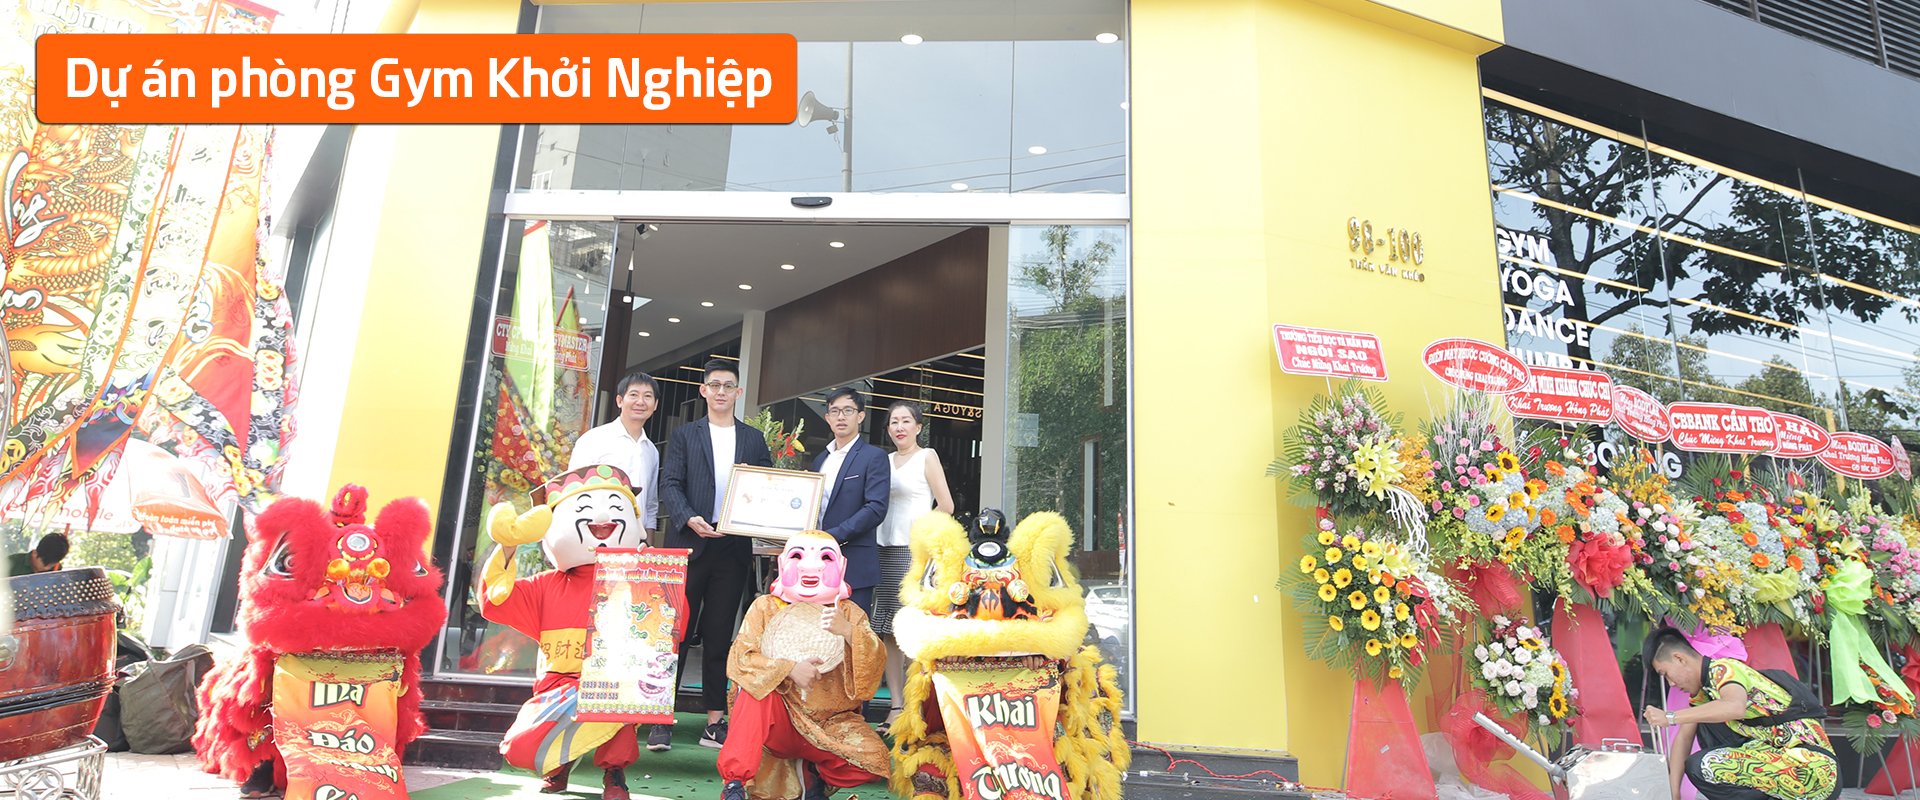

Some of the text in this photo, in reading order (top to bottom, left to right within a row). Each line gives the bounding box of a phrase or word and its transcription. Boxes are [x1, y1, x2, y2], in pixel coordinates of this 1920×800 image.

[1347, 216, 1424, 266] 98-100
[1496, 227, 1550, 263] GYM
[1295, 344, 1368, 360] NGÔI SAO
[1509, 347, 1589, 371] UMBA
[1292, 356, 1311, 368] Chúc
[1311, 358, 1333, 373] Mừng
[1333, 361, 1350, 372] Khai
[1508, 395, 1531, 410] Khai
[1589, 403, 1610, 417] Phát
[1671, 413, 1720, 431] CBBANK
[1678, 432, 1698, 444] Chúc
[1699, 433, 1725, 447] Mừng
[1726, 434, 1746, 445] Khai
[1580, 438, 1683, 479] BONG
[967, 692, 1036, 728] Khai
